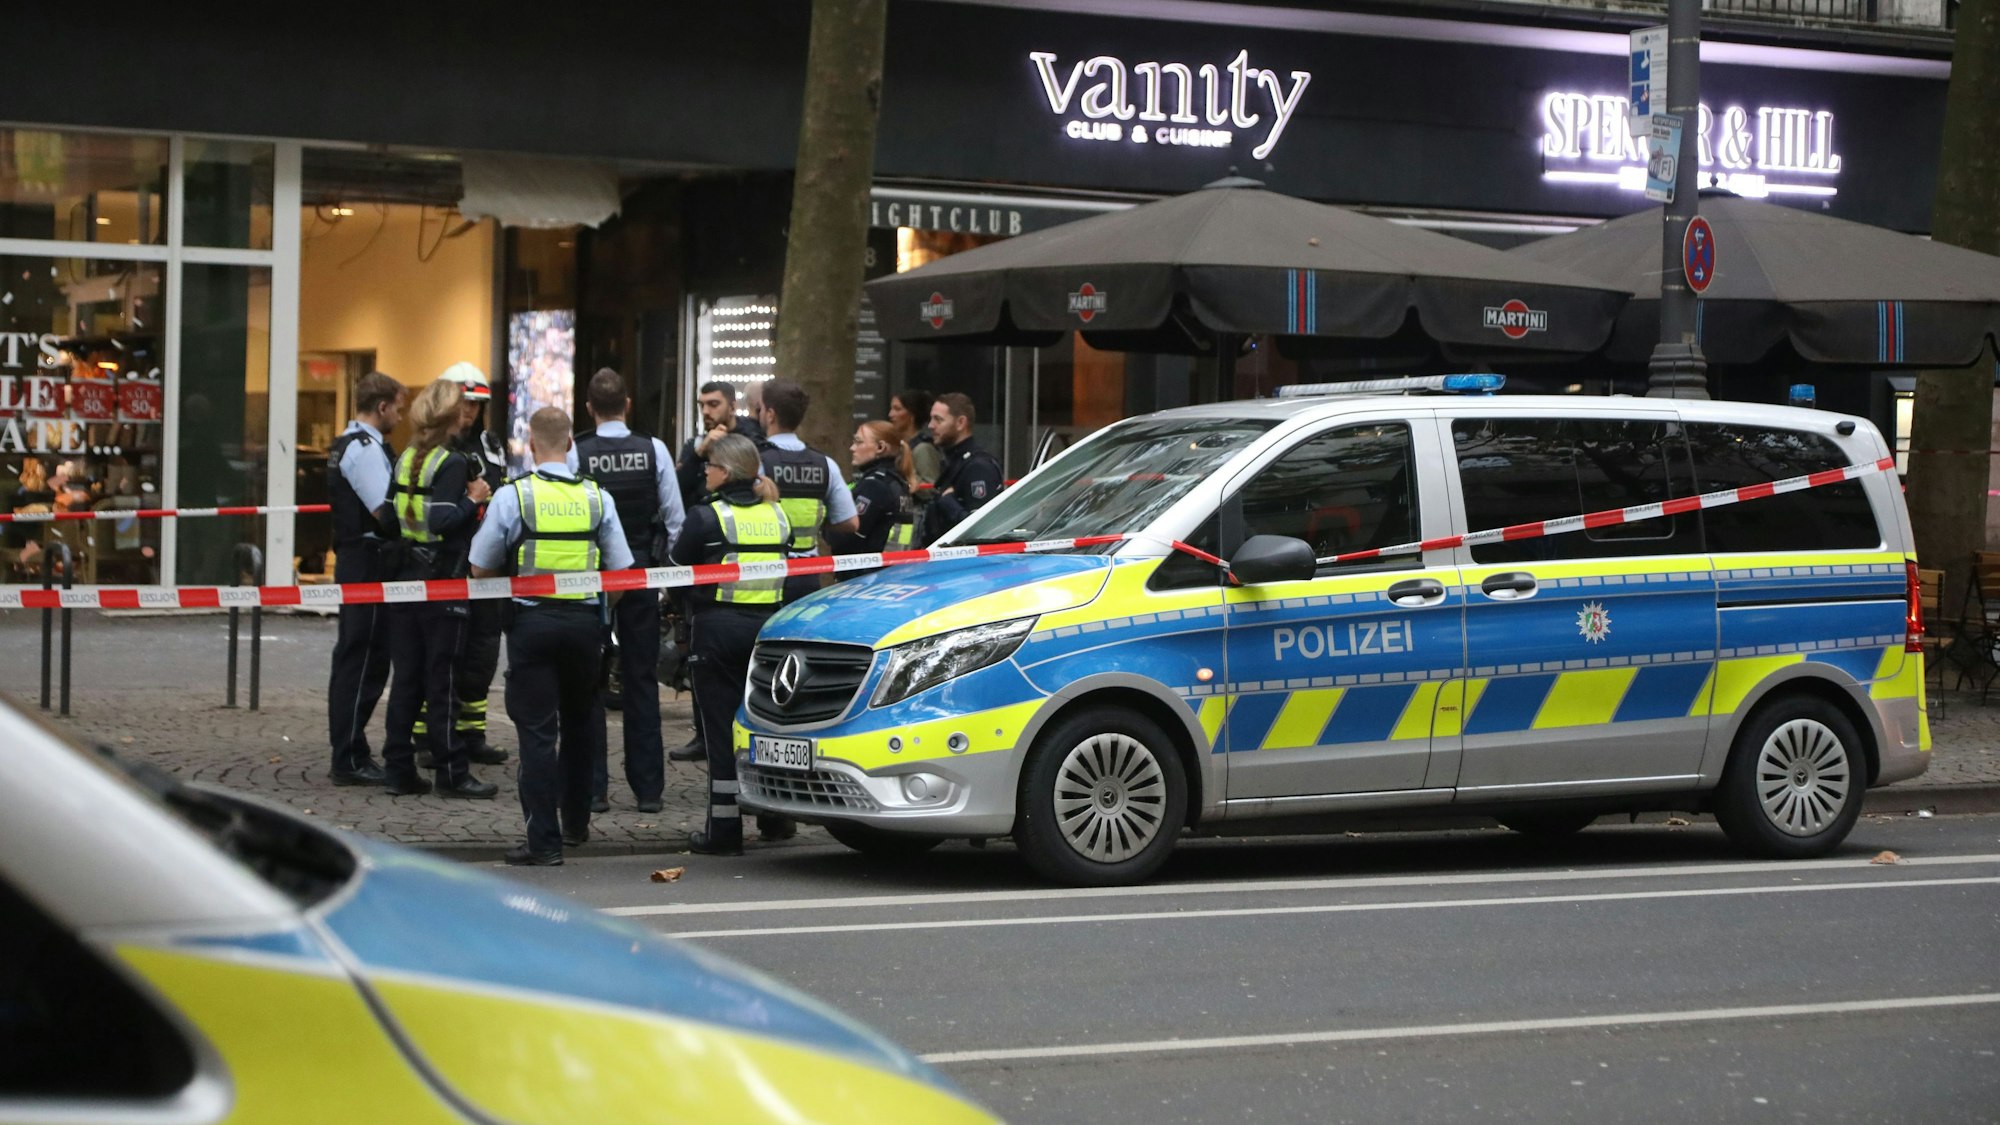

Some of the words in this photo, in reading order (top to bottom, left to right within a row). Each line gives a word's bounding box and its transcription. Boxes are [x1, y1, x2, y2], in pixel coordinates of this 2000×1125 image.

[1029, 49, 1311, 160] vanity
[1066, 120, 1122, 142] CLUB
[1131, 124, 1149, 143] &
[1155, 127, 1233, 148] CUISINE
[1544, 92, 1713, 166] SPENR
[1722, 106, 1753, 168] &
[1757, 107, 1841, 173] HILL
[1069, 294, 1106, 310] MARTINI
[1486, 309, 1545, 328] MARTINI
[588, 453, 649, 473] POLIZEI
[773, 465, 824, 484] POLIZEI
[540, 502, 586, 517] POLIZEI
[739, 521, 779, 537] POLIZEI
[1273, 619, 1413, 661] POLIZEI
[755, 740, 770, 762] NRW
[774, 742, 809, 766] 5-6508
